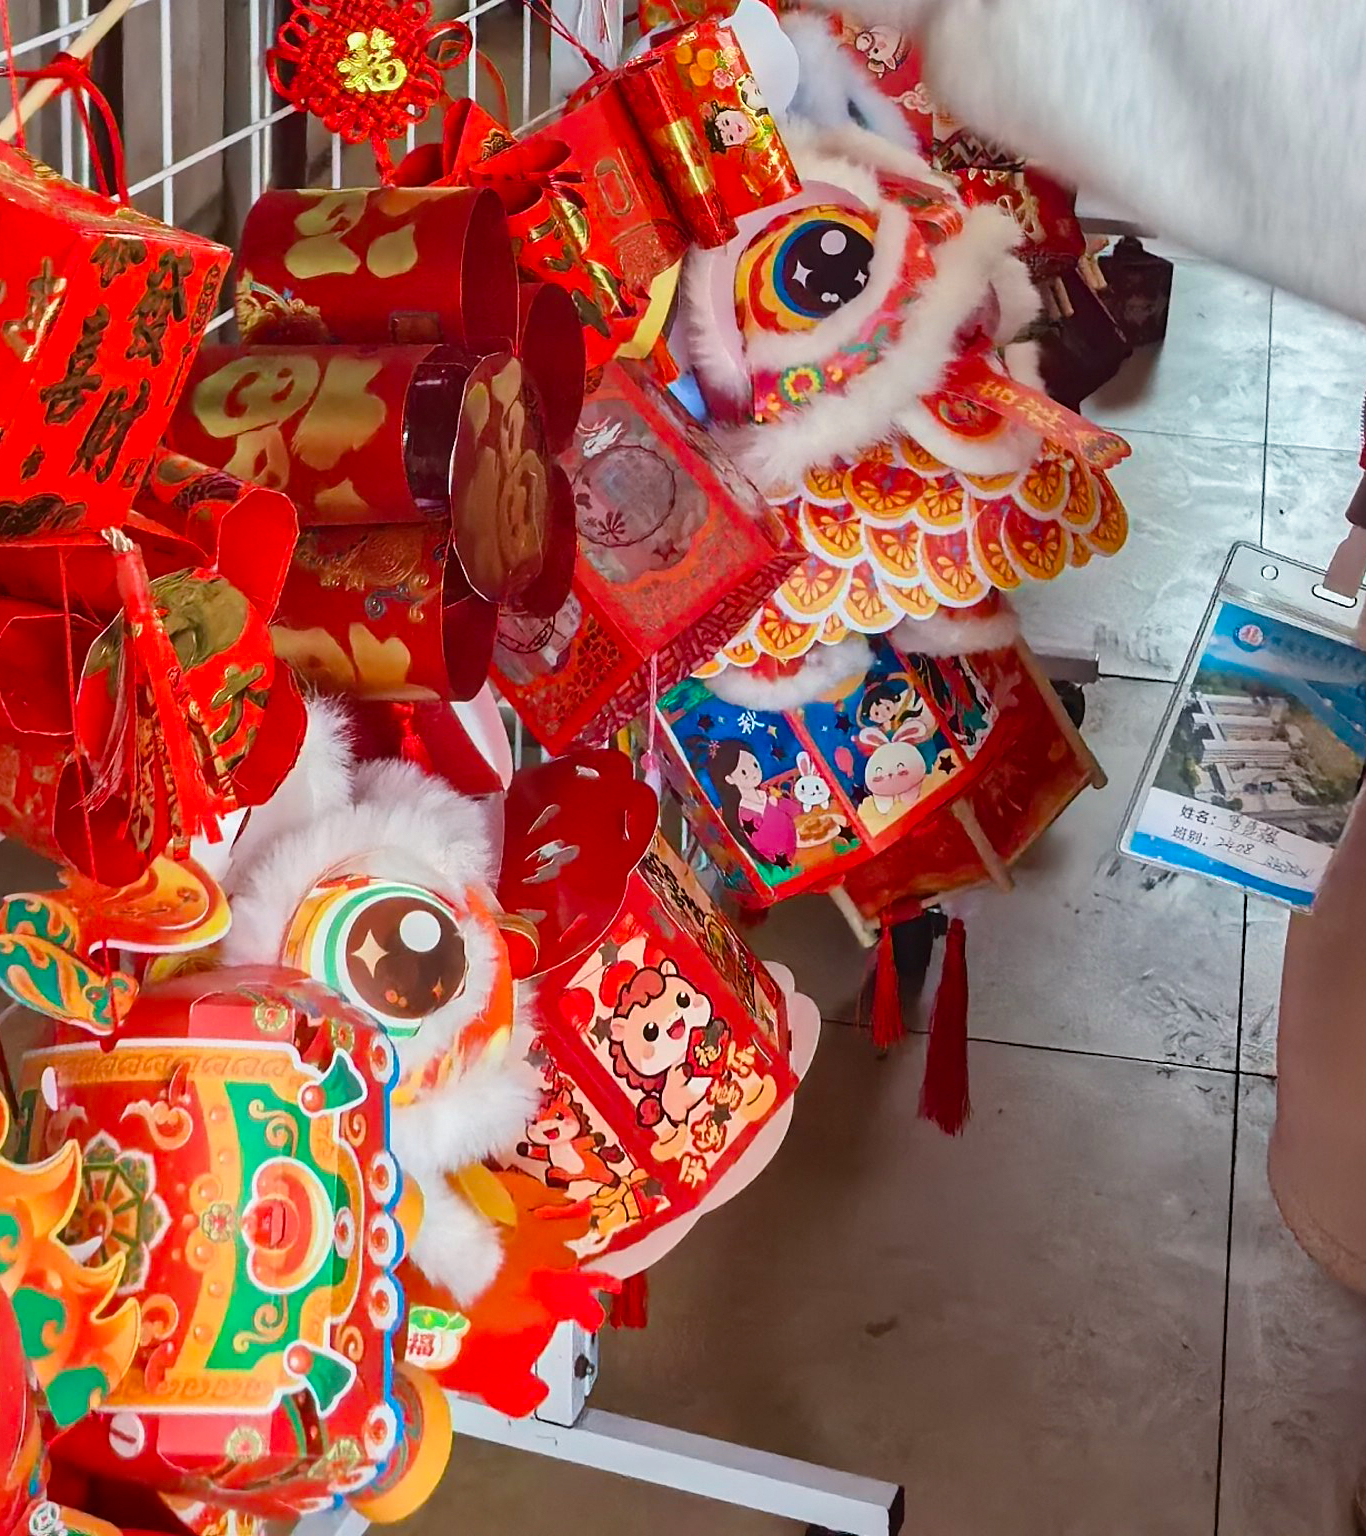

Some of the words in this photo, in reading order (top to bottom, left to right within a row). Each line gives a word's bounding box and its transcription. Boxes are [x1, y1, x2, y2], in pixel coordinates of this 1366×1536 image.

[337, 27, 407, 93] 福
[736, 710, 765, 735] 秋
[1181, 804, 1217, 826] 姓名：
